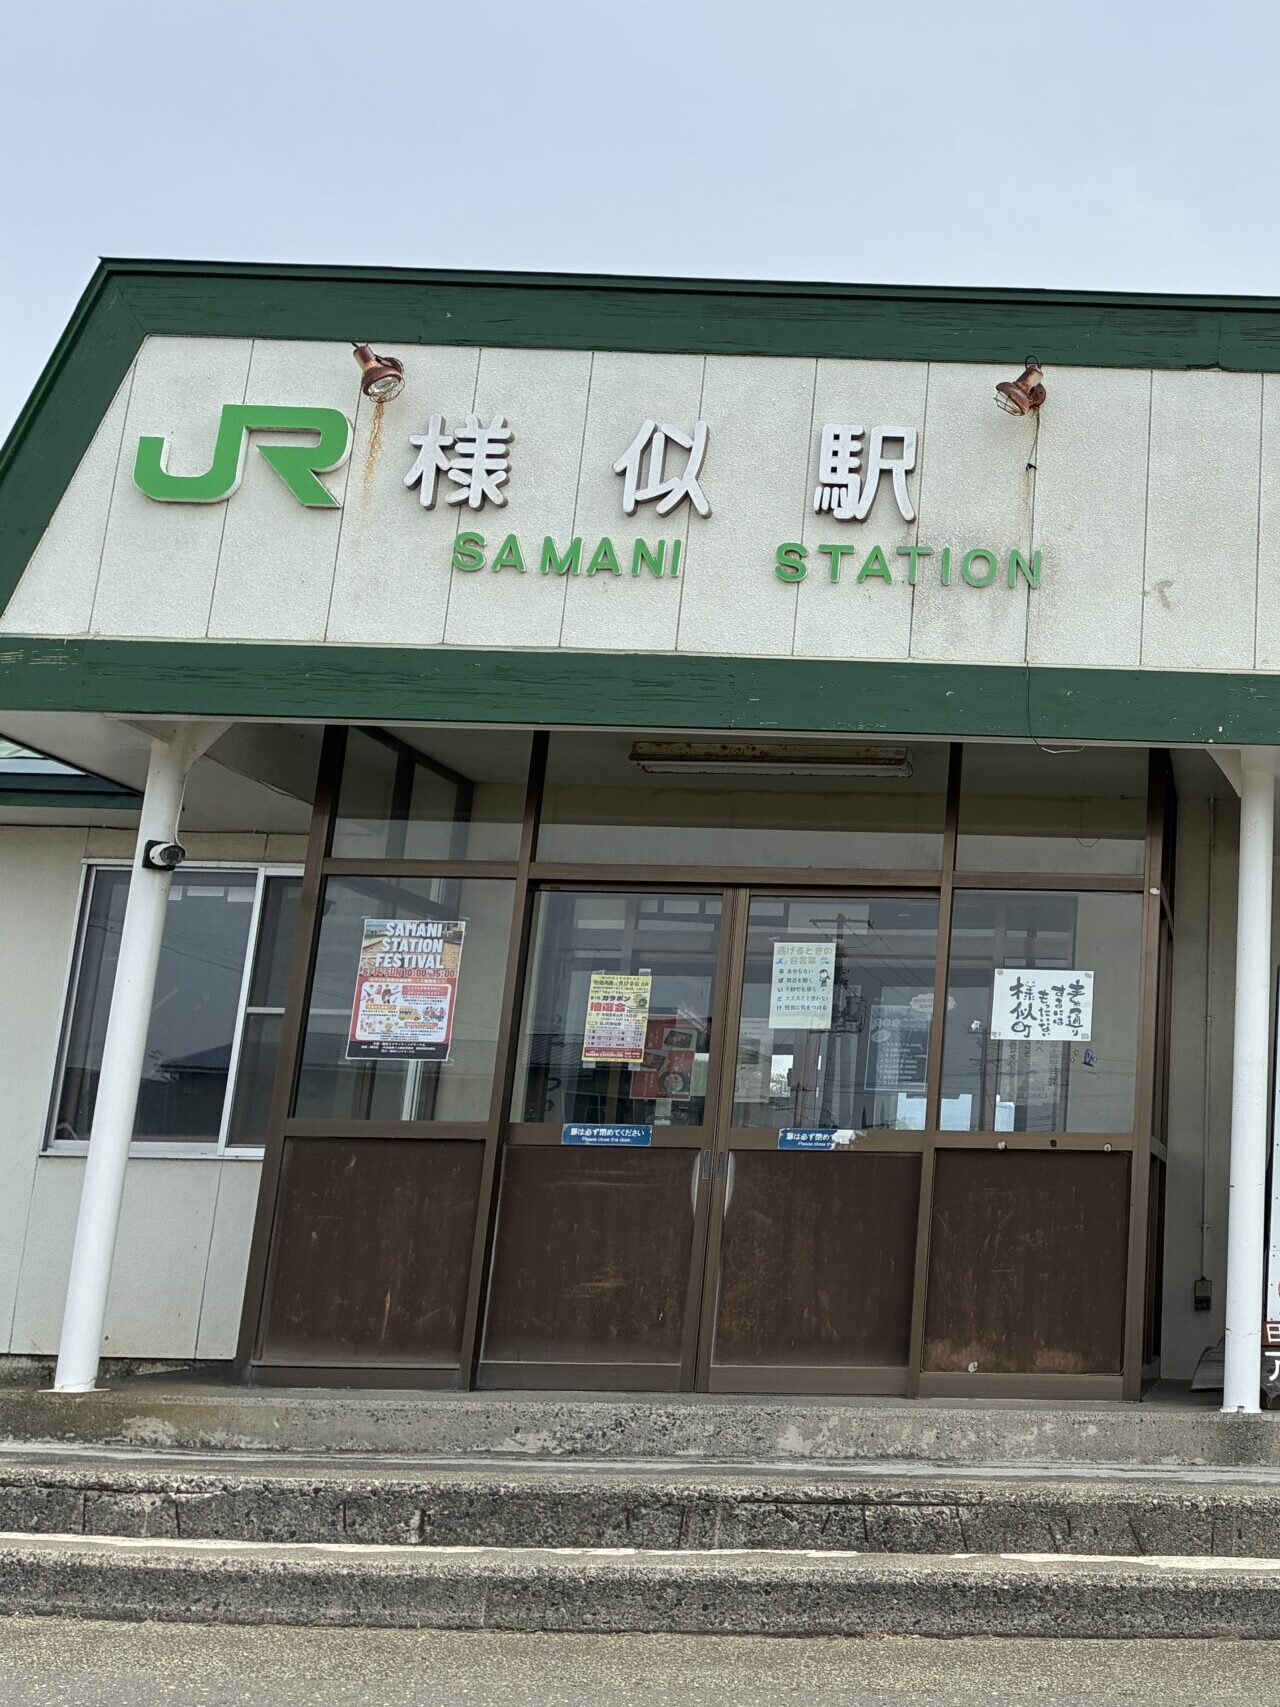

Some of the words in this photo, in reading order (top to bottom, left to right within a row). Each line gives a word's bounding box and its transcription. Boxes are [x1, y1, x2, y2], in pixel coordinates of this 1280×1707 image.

[133, 403, 353, 509] JR
[404, 413, 918, 523] 様似駅
[452, 530, 683, 579] SAMANI
[775, 541, 1044, 591] STATION
[381, 938, 443, 953] STATION
[386, 922, 443, 938] SAMANI
[375, 953, 444, 969] FESTIVAL
[1009, 976, 1038, 1038] 様似町
[1038, 989, 1051, 1037] もったいない
[1051, 984, 1066, 1026] するには
[570, 1127, 645, 1137] 扉は必ず閉めてください
